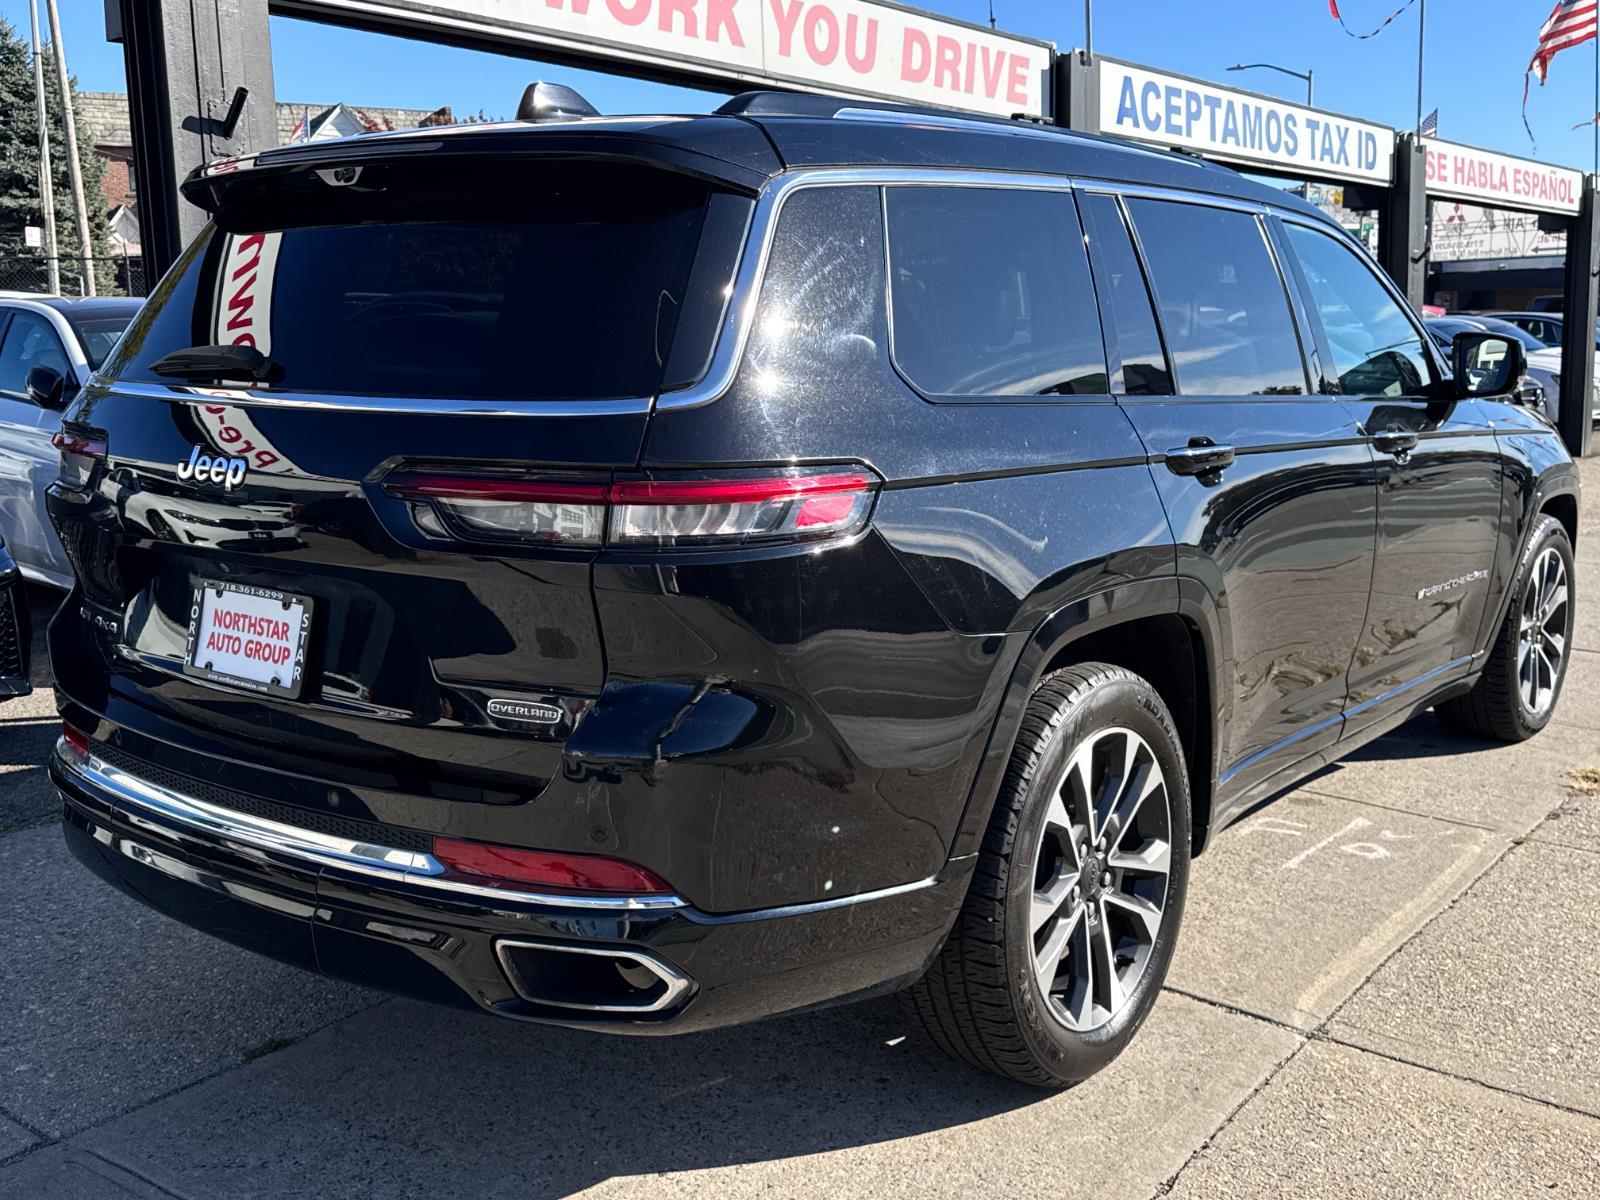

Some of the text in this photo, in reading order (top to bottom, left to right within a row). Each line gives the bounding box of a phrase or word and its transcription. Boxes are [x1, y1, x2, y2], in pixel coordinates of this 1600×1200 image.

[545, 0, 1030, 106] RK YOU DRIVE
[1116, 75, 1377, 171] ACEPTAMOS TAX ID
[1426, 150, 1574, 204] SE HABLA ESPAÑOL
[177, 445, 247, 492] Jeep
[219, 582, 284, 600] 718-361-6299
[183, 588, 202, 666] NORTH
[206, 631, 292, 666] AUTO GROUP
[213, 608, 291, 642] NORTHSTAR
[293, 613, 310, 681] STAR
[490, 703, 558, 719] OVERLAND
